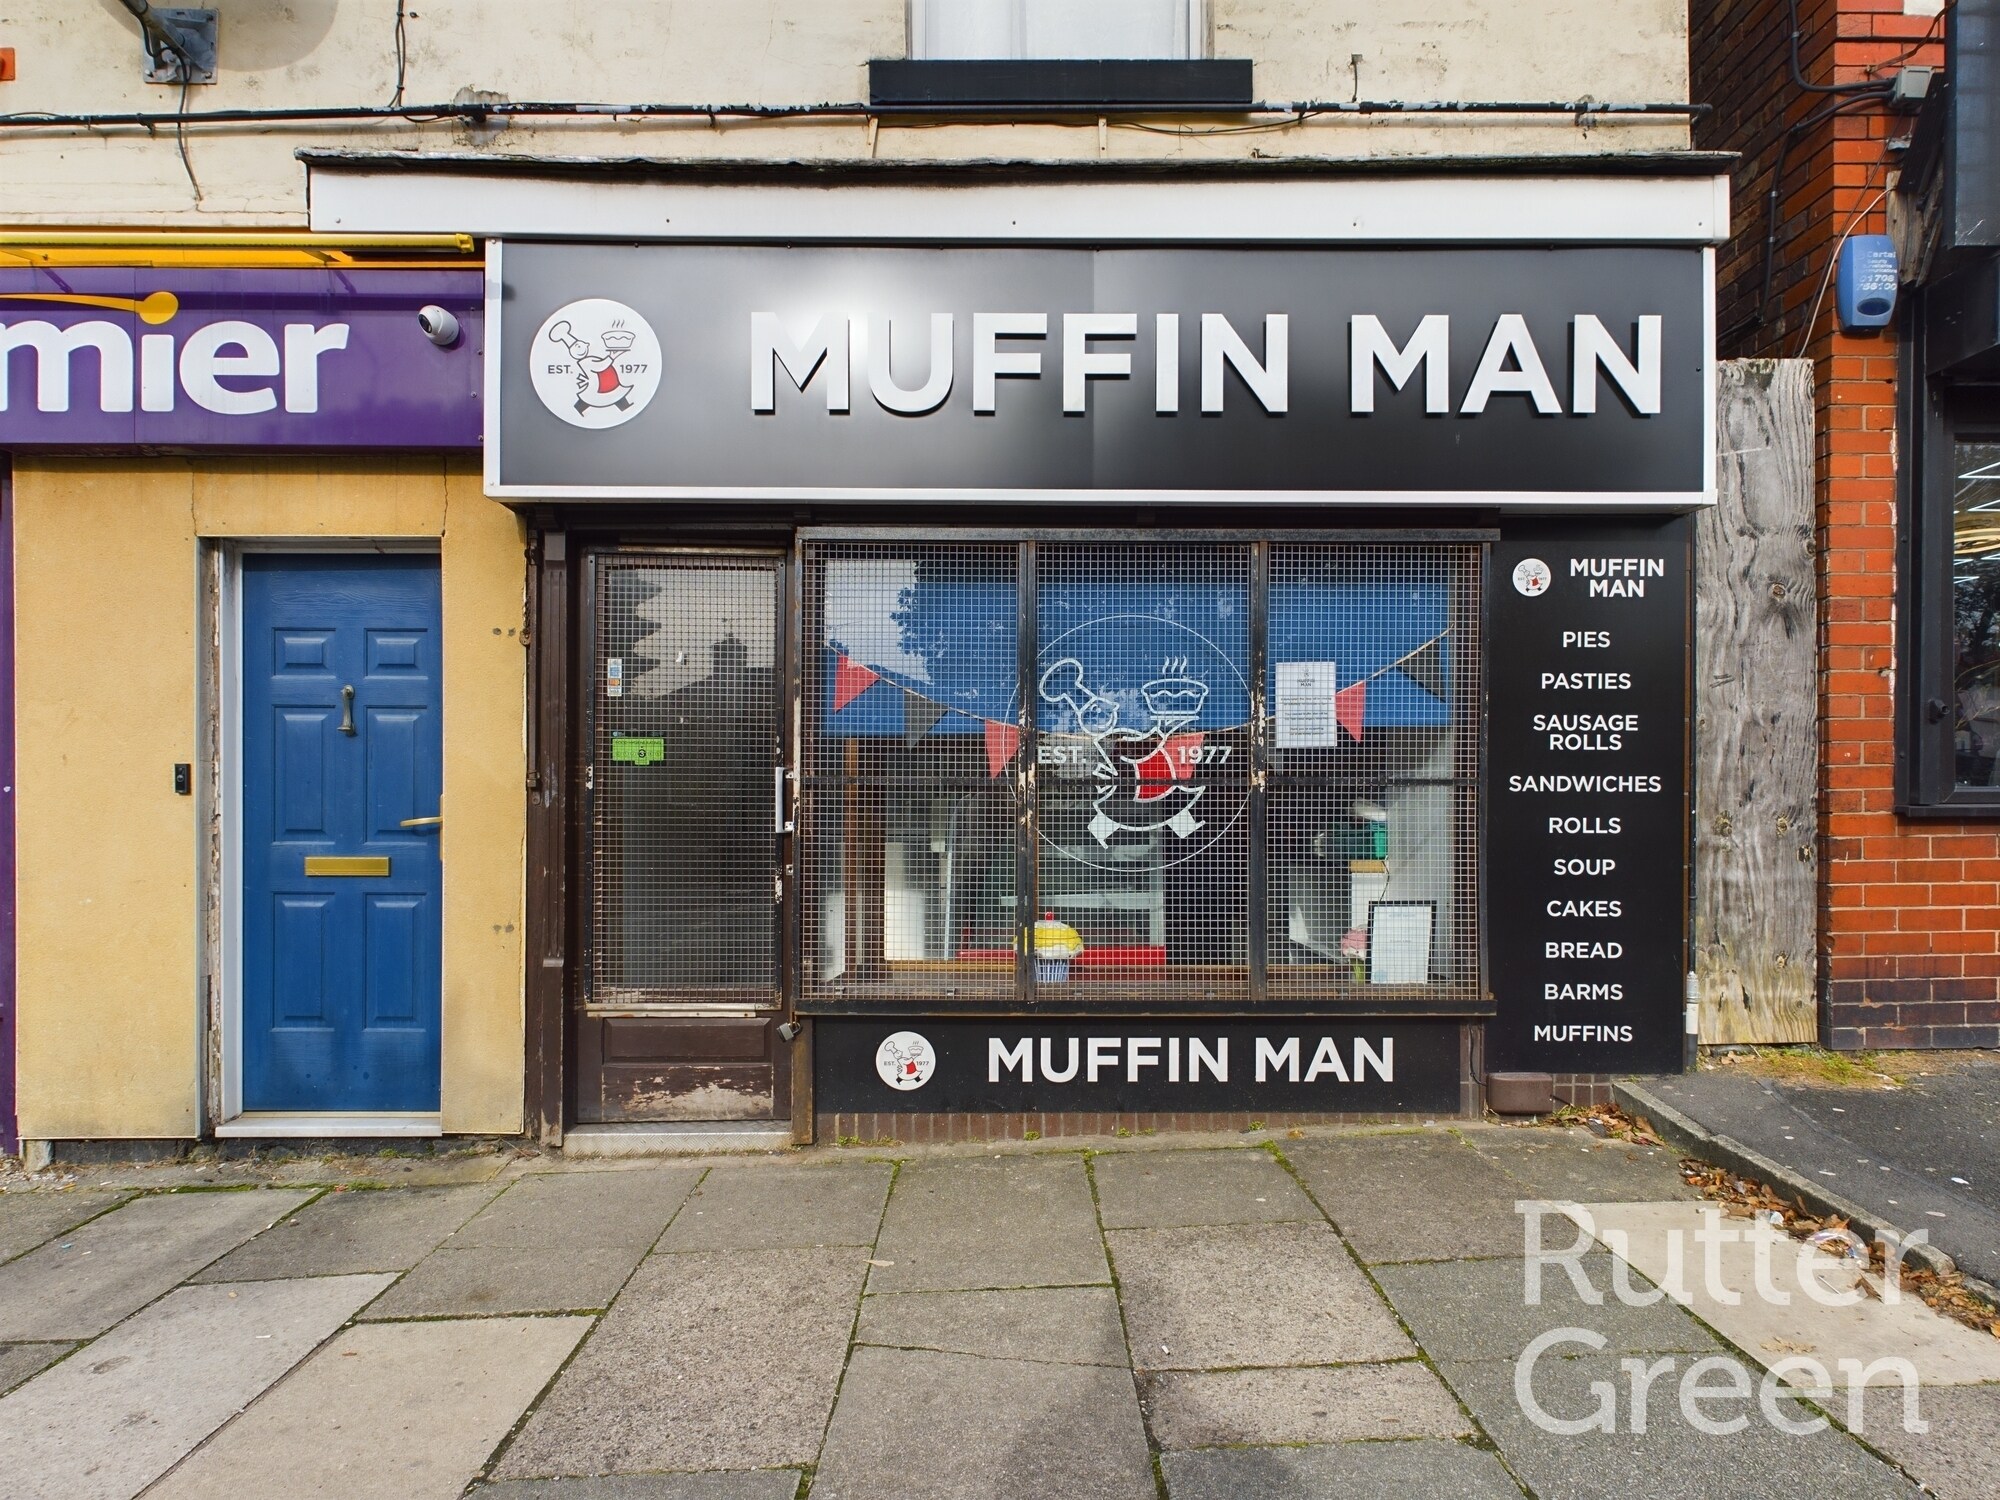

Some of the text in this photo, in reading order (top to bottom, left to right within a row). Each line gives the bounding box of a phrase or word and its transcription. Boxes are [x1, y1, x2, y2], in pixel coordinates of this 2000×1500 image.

[547, 364, 648, 374] EST. 1977
[750, 311, 1664, 416] MUFFIN MAN
[1570, 558, 1664, 577] MUFFIN
[1589, 579, 1645, 598] MAN
[1562, 631, 1611, 648] PIES
[1541, 672, 1632, 690] PASTIES
[1533, 714, 1639, 732] SAUSAGE
[1549, 733, 1622, 751] ROLLS
[1037, 745, 1232, 765] EST. 1977
[1508, 775, 1662, 793] SANDWICHES
[1548, 817, 1622, 834] ROLLS
[1553, 858, 1616, 876] SOUP
[1546, 900, 1622, 918] CAKES
[1545, 941, 1623, 959] BREAD
[1544, 983, 1623, 1001] BARMS
[1534, 1025, 1633, 1042] MUFFINS
[988, 1036, 1394, 1083] MUFFIN MAN
